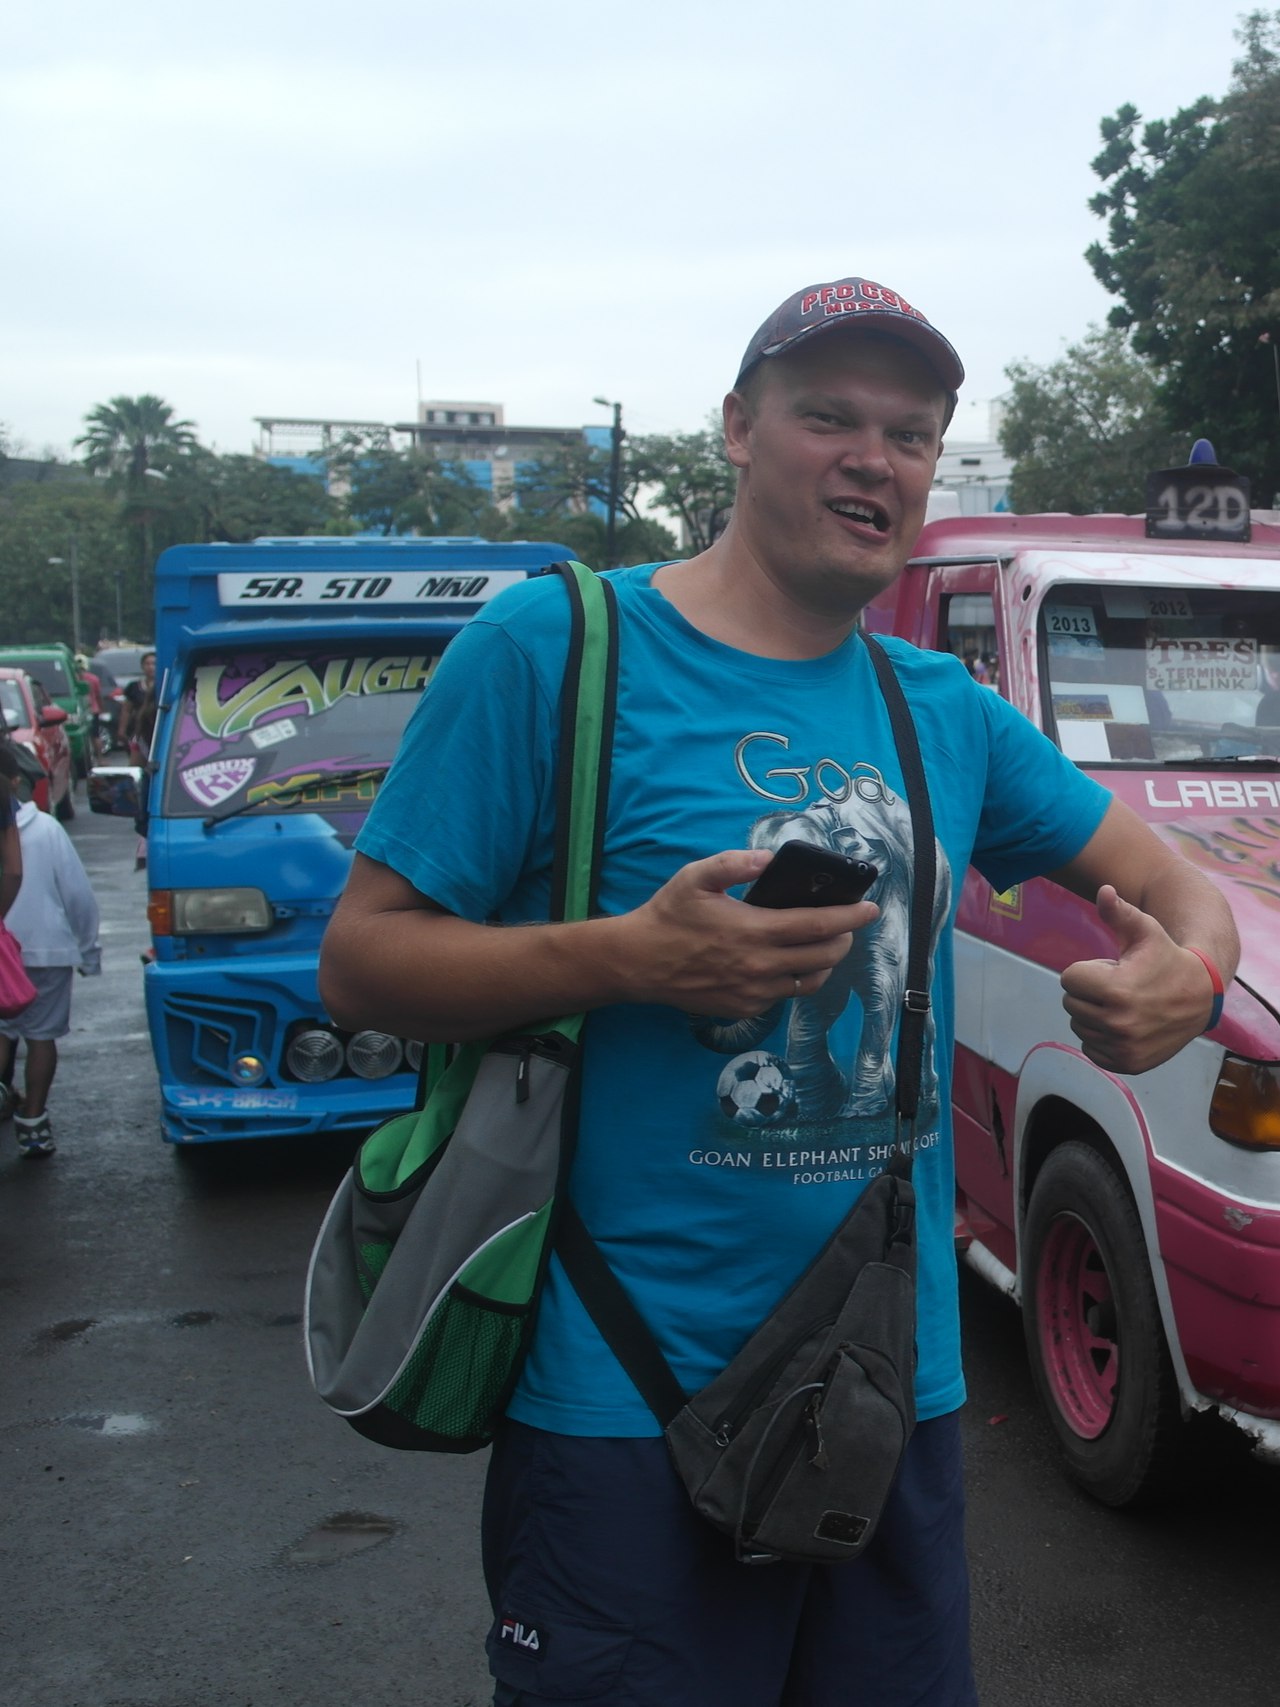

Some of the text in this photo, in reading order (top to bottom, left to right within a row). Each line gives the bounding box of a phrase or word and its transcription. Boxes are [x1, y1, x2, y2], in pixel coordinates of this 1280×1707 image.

[801, 284, 855, 315] PFC
[1156, 485, 1248, 531] 12D
[239, 577, 303, 599] SR.
[320, 576, 392, 599] STO
[1052, 615, 1091, 633] 2013
[1152, 639, 1255, 665] TRES
[1165, 667, 1251, 679] TERMINAL
[734, 731, 895, 806] Goa
[689, 1150, 751, 1167] GOAN
[763, 1147, 860, 1168] ELEPHANT
[793, 1170, 865, 1184] FOOTBALL
[501, 1619, 540, 1650] FILA
